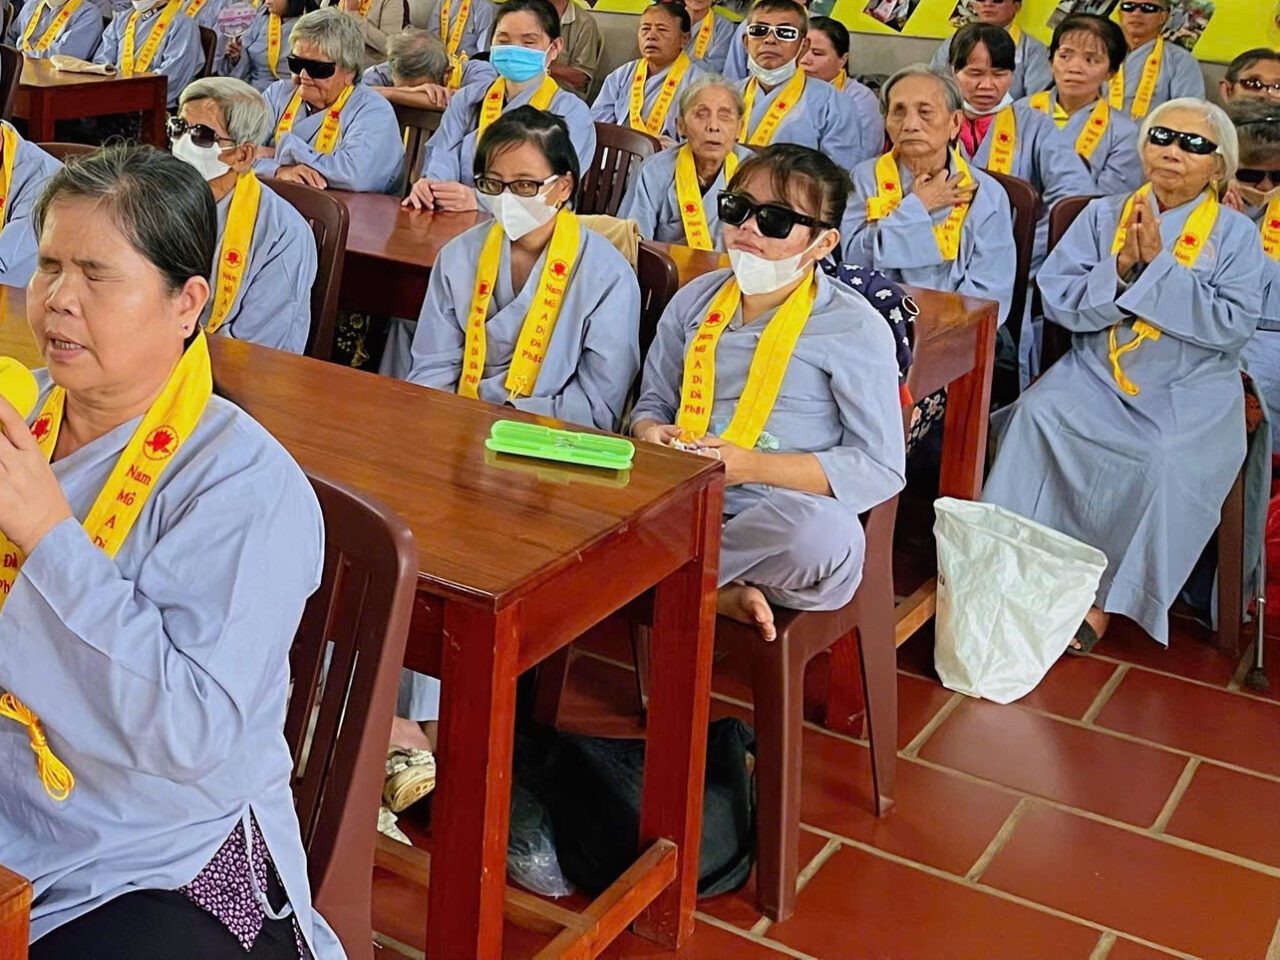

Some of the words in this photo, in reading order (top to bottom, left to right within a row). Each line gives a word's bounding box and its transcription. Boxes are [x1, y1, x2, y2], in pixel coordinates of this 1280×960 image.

[694, 360, 702, 369] A
[692, 375, 702, 385] Di
[690, 390, 702, 400] Đà
[684, 404, 705, 416] Phật
[125, 463, 152, 487] Nam
[116, 488, 137, 507] Mô
[105, 515, 117, 529] A
